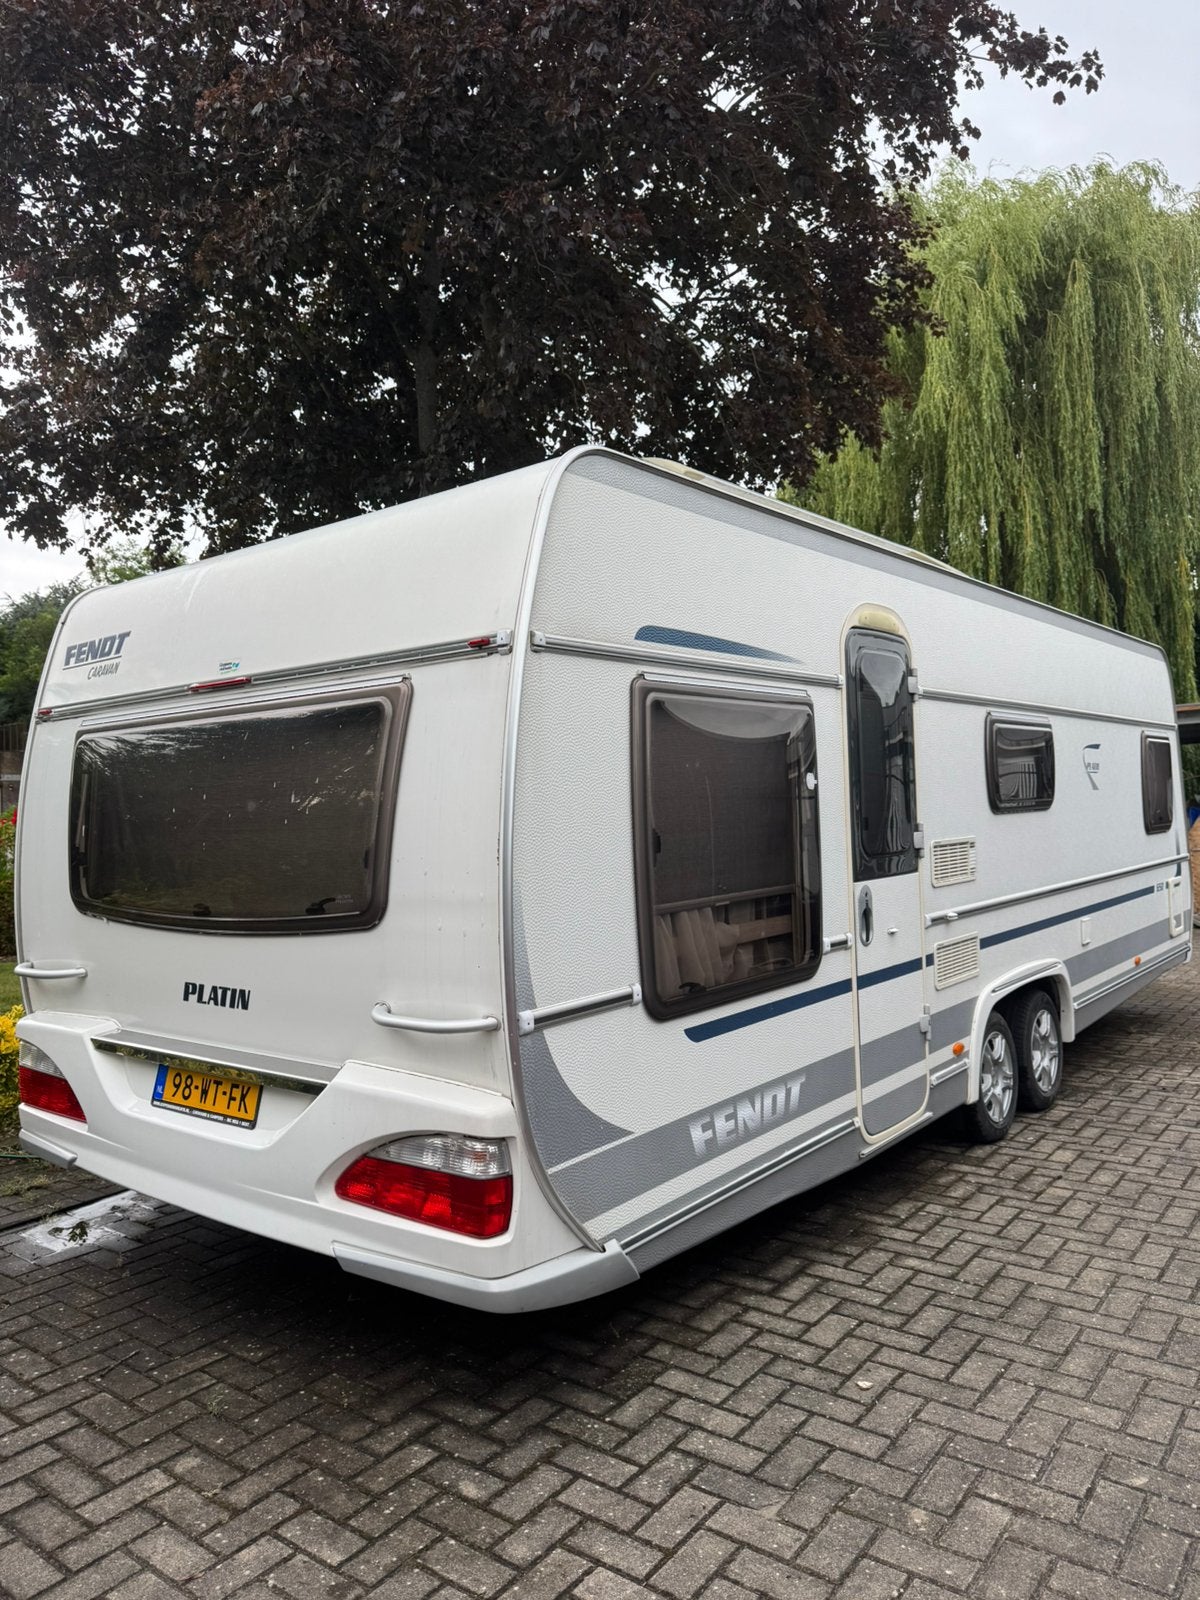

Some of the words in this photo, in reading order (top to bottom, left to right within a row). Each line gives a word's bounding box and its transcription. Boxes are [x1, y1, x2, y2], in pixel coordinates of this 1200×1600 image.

[64, 631, 132, 667] FENDT
[87, 662, 120, 680] CARAVAN
[183, 982, 251, 1010] PLATIN
[172, 1072, 252, 1114] 98-WT-FK
[689, 1074, 806, 1156] FENDT
